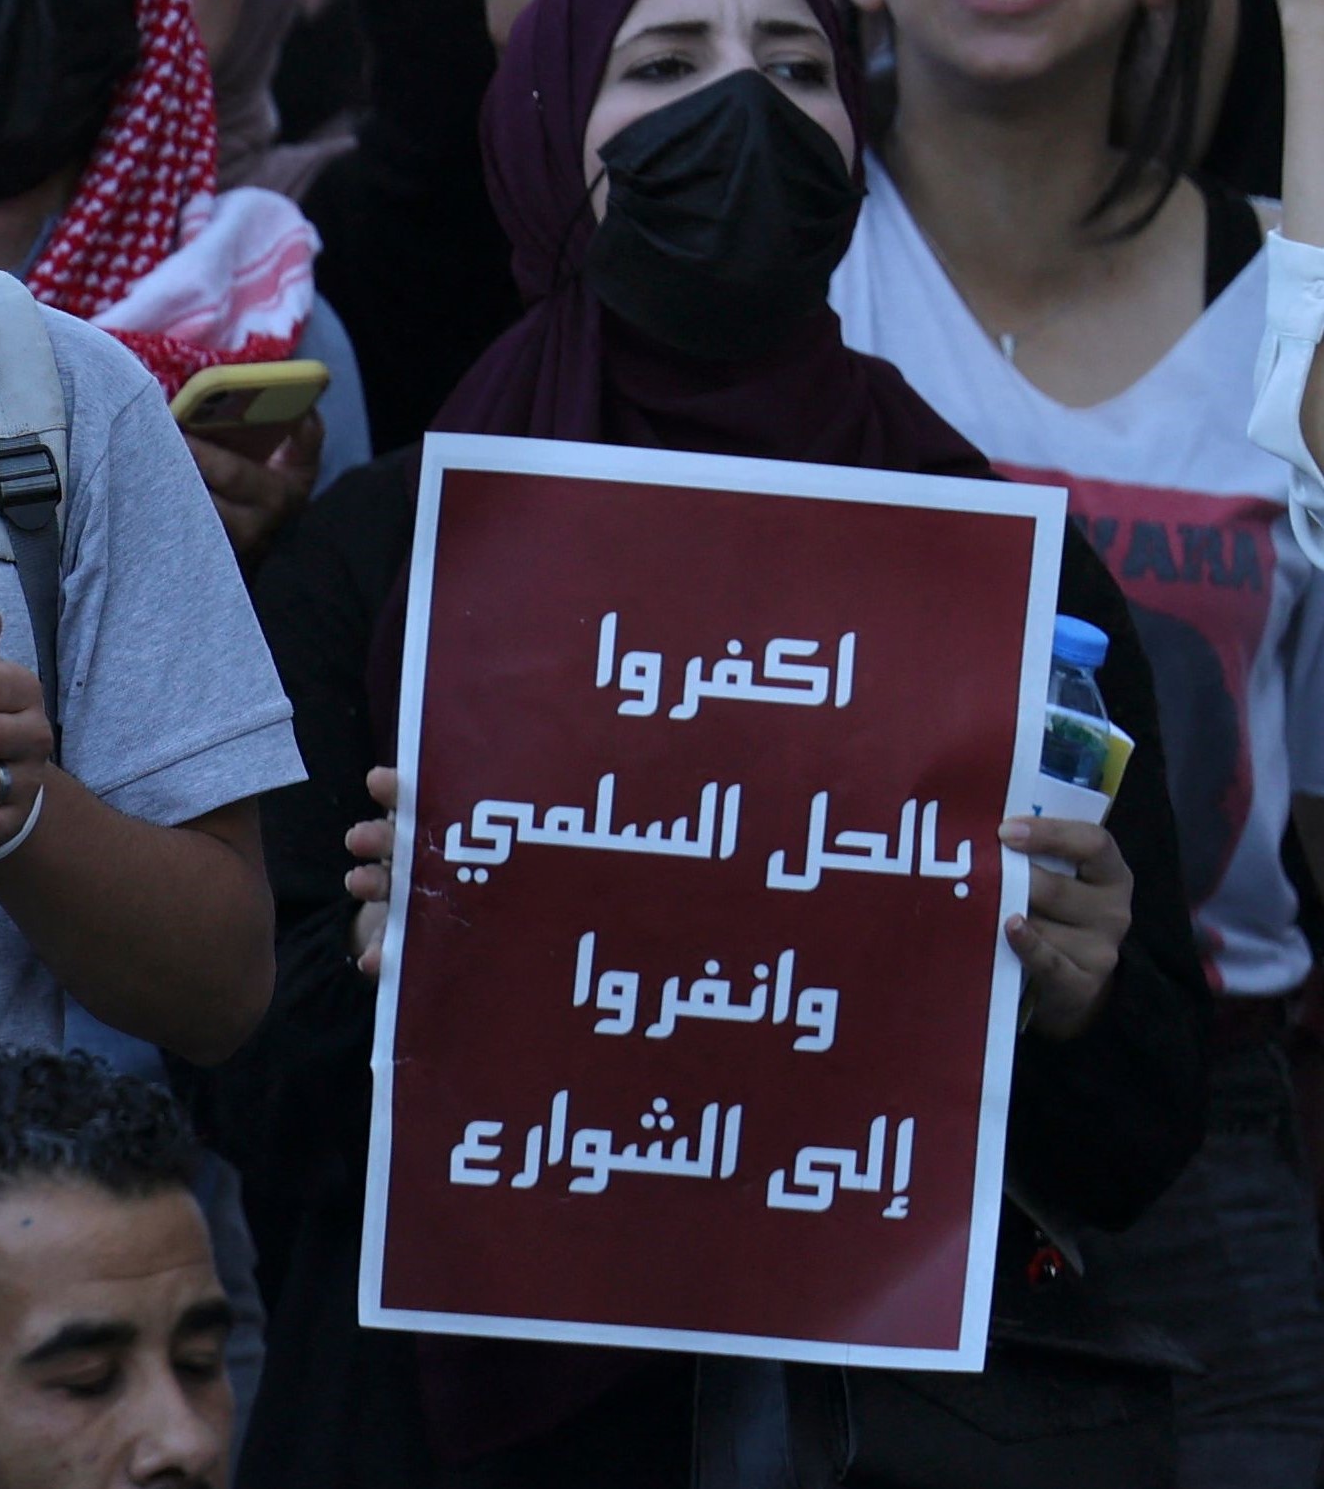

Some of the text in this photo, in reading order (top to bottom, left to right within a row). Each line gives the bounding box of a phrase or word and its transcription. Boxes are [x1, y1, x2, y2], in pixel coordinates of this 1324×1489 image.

[595, 611, 856, 720] اكفروا
[443, 773, 972, 898] بالحل السلمي
[573, 931, 839, 1052] وانفروا
[449, 1090, 914, 1219] إلى الشوارع
